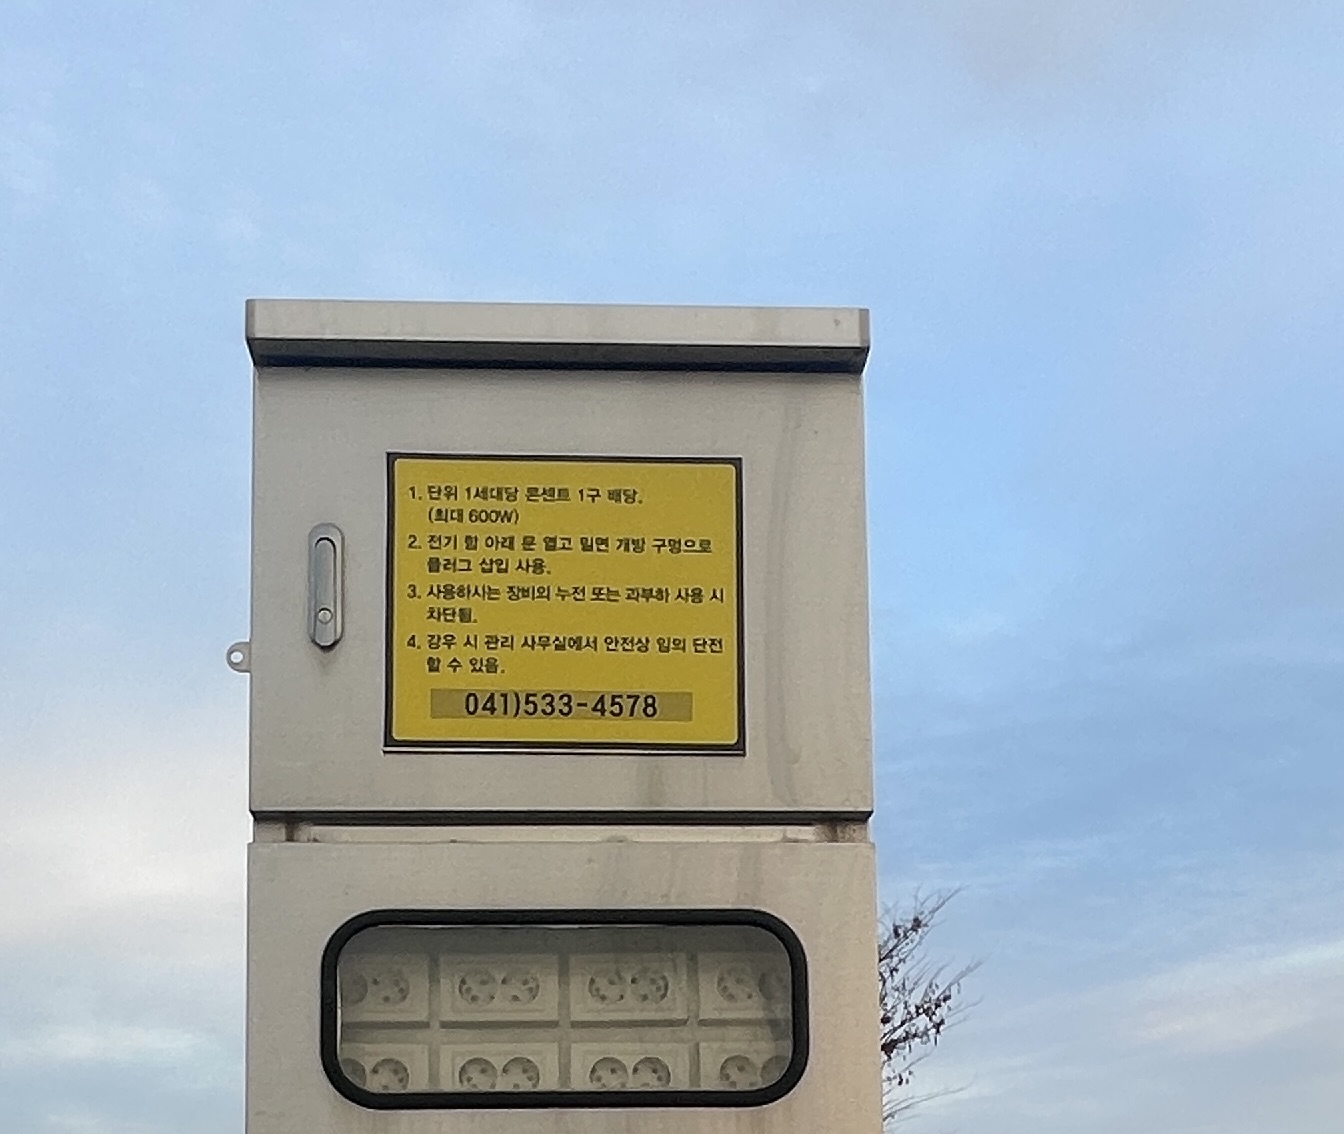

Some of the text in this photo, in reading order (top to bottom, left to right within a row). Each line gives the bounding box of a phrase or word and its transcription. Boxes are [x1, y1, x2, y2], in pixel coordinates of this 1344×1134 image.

[427, 485, 458, 501] 단위
[464, 486, 519, 502] 1세대당
[525, 487, 572, 502] 콘센트
[578, 487, 602, 503] 1구
[607, 488, 643, 504] 배당.
[468, 508, 520, 525] 600W)
[407, 534, 422, 550] 2.
[427, 534, 458, 550] 전기
[485, 535, 515, 551] 아래
[616, 537, 646, 554] 개방
[651, 538, 713, 554] 구멍으로
[427, 556, 551, 575] 플러그 삽입 사용.
[407, 584, 422, 600] 3.
[426, 583, 501, 600] 사용하시는
[556, 585, 586, 601] 누전
[590, 586, 621, 602] 또는
[625, 587, 670, 603] 과부하
[674, 587, 704, 604] 사용
[709, 587, 724, 604] 시
[406, 634, 422, 650] 4.
[426, 634, 457, 650] 강우
[463, 634, 478, 650] 시
[484, 634, 514, 651] 관리
[521, 635, 598, 652] 사무실에서
[604, 636, 650, 652] 안전상
[692, 637, 723, 653] 단전
[446, 657, 462, 673] 수
[465, 692, 657, 718] 041)533-4578
